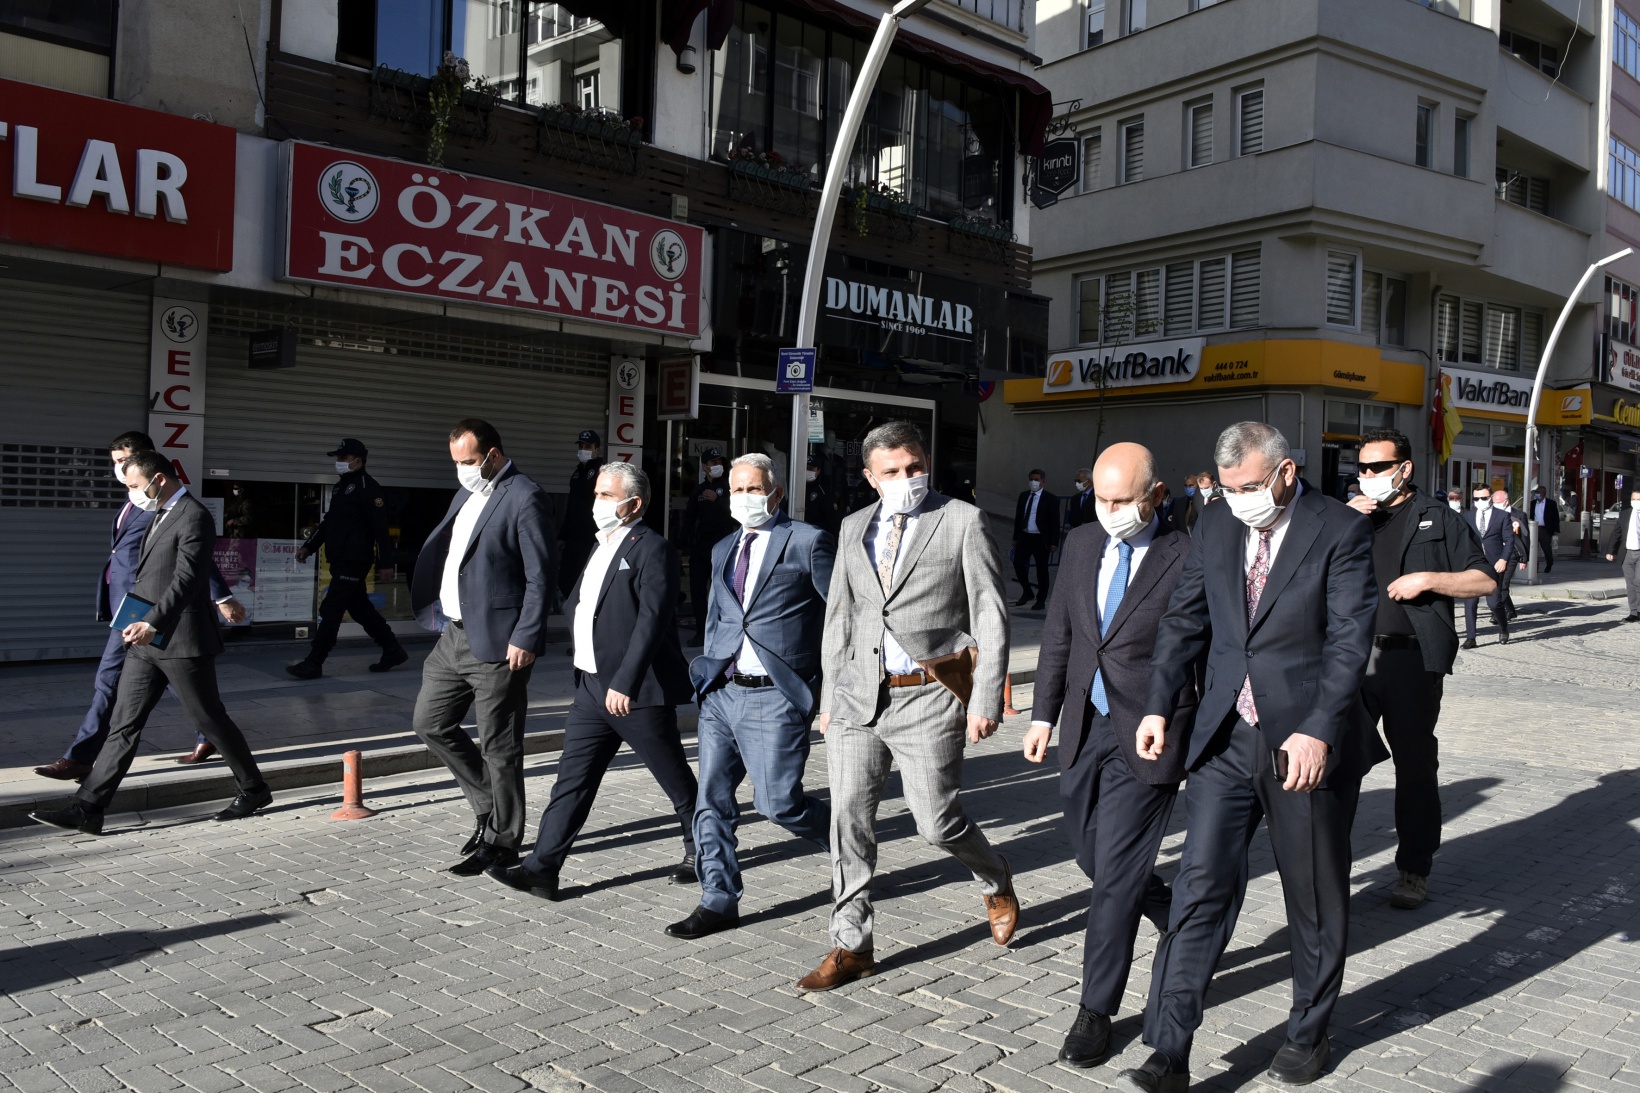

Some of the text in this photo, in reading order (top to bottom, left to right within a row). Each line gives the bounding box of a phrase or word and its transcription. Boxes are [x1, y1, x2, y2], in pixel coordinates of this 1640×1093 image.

[397, 173, 640, 268] ÖZKAN
[318, 230, 687, 329] ECZANESİ
[825, 276, 973, 335] DUMANLAR
[905, 325, 926, 335] 1969
[666, 369, 686, 407] E
[1214, 360, 1248, 371] 444 0 724
